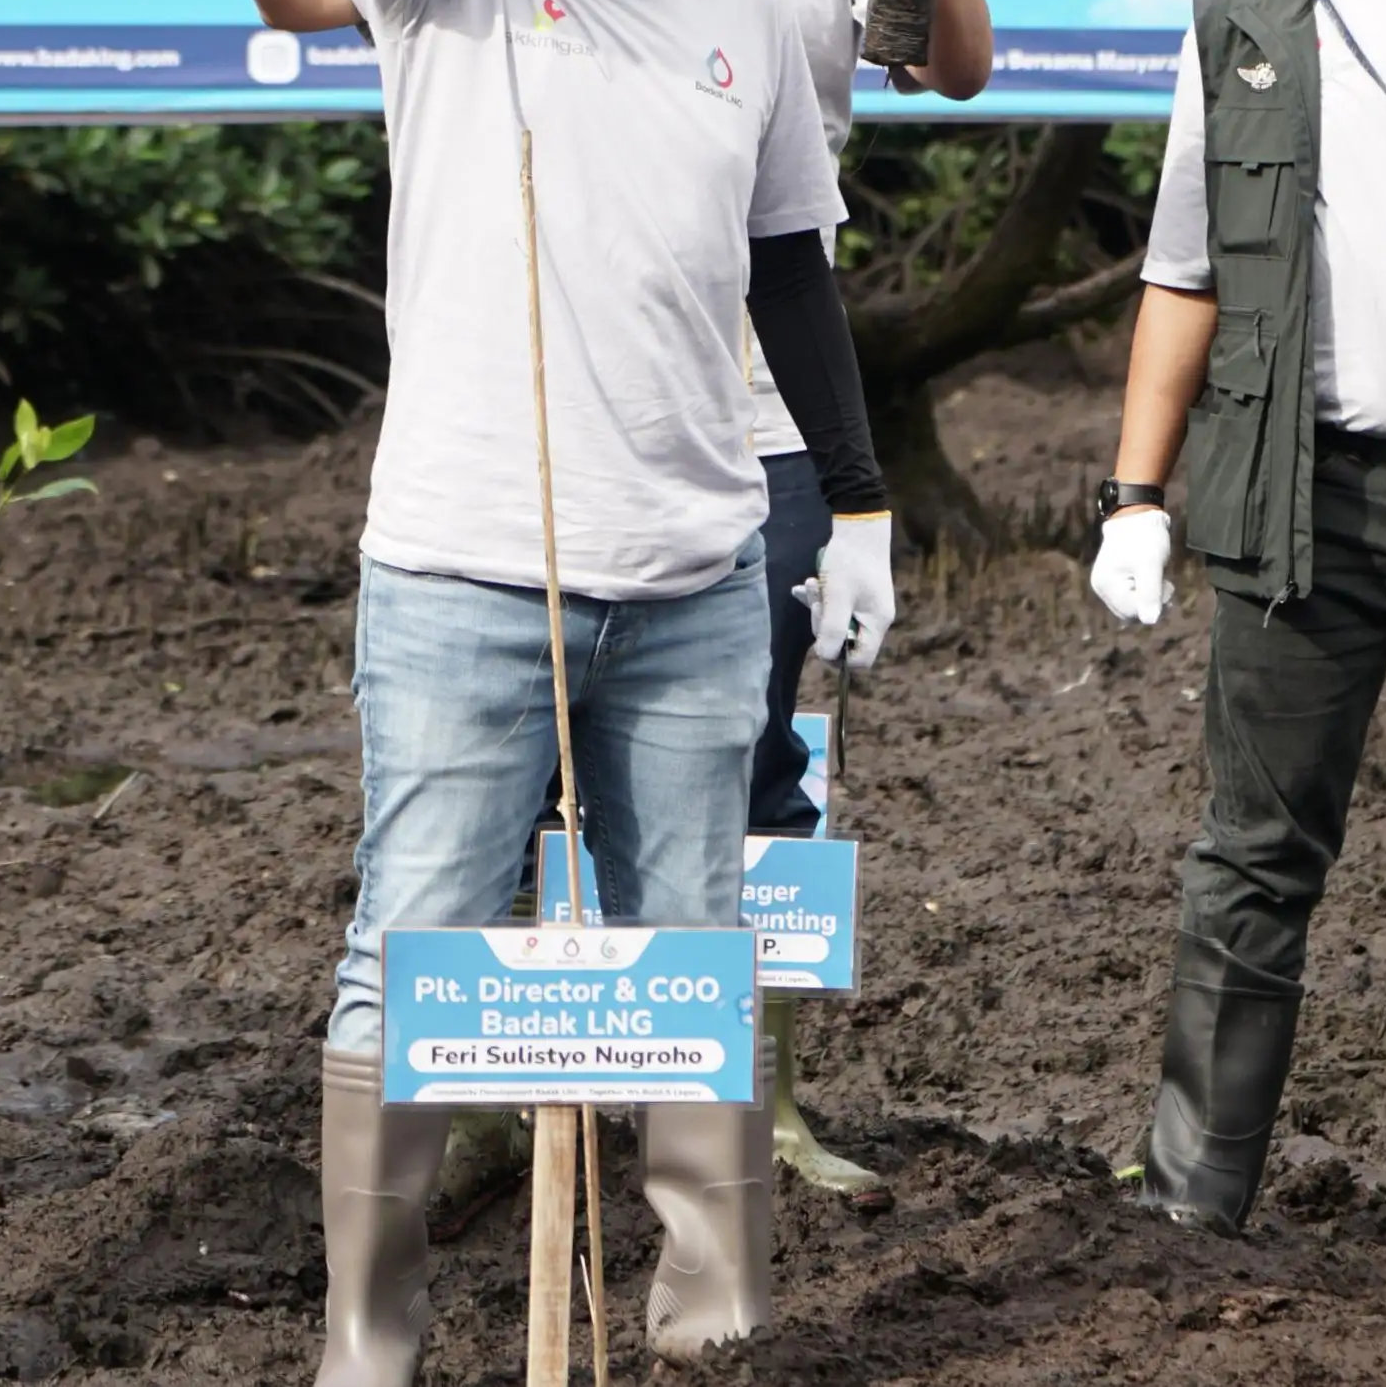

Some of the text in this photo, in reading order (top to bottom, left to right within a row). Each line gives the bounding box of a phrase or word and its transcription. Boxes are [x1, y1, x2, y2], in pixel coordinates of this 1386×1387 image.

[695, 81, 744, 109] Badak LNG
[742, 884, 801, 906] ager
[763, 938, 781, 955] P.
[415, 976, 720, 1004] Plt. Director & COO
[481, 1009, 654, 1037] Badak LNG
[431, 1044, 704, 1069] Feri Sulistyo Nugroho
